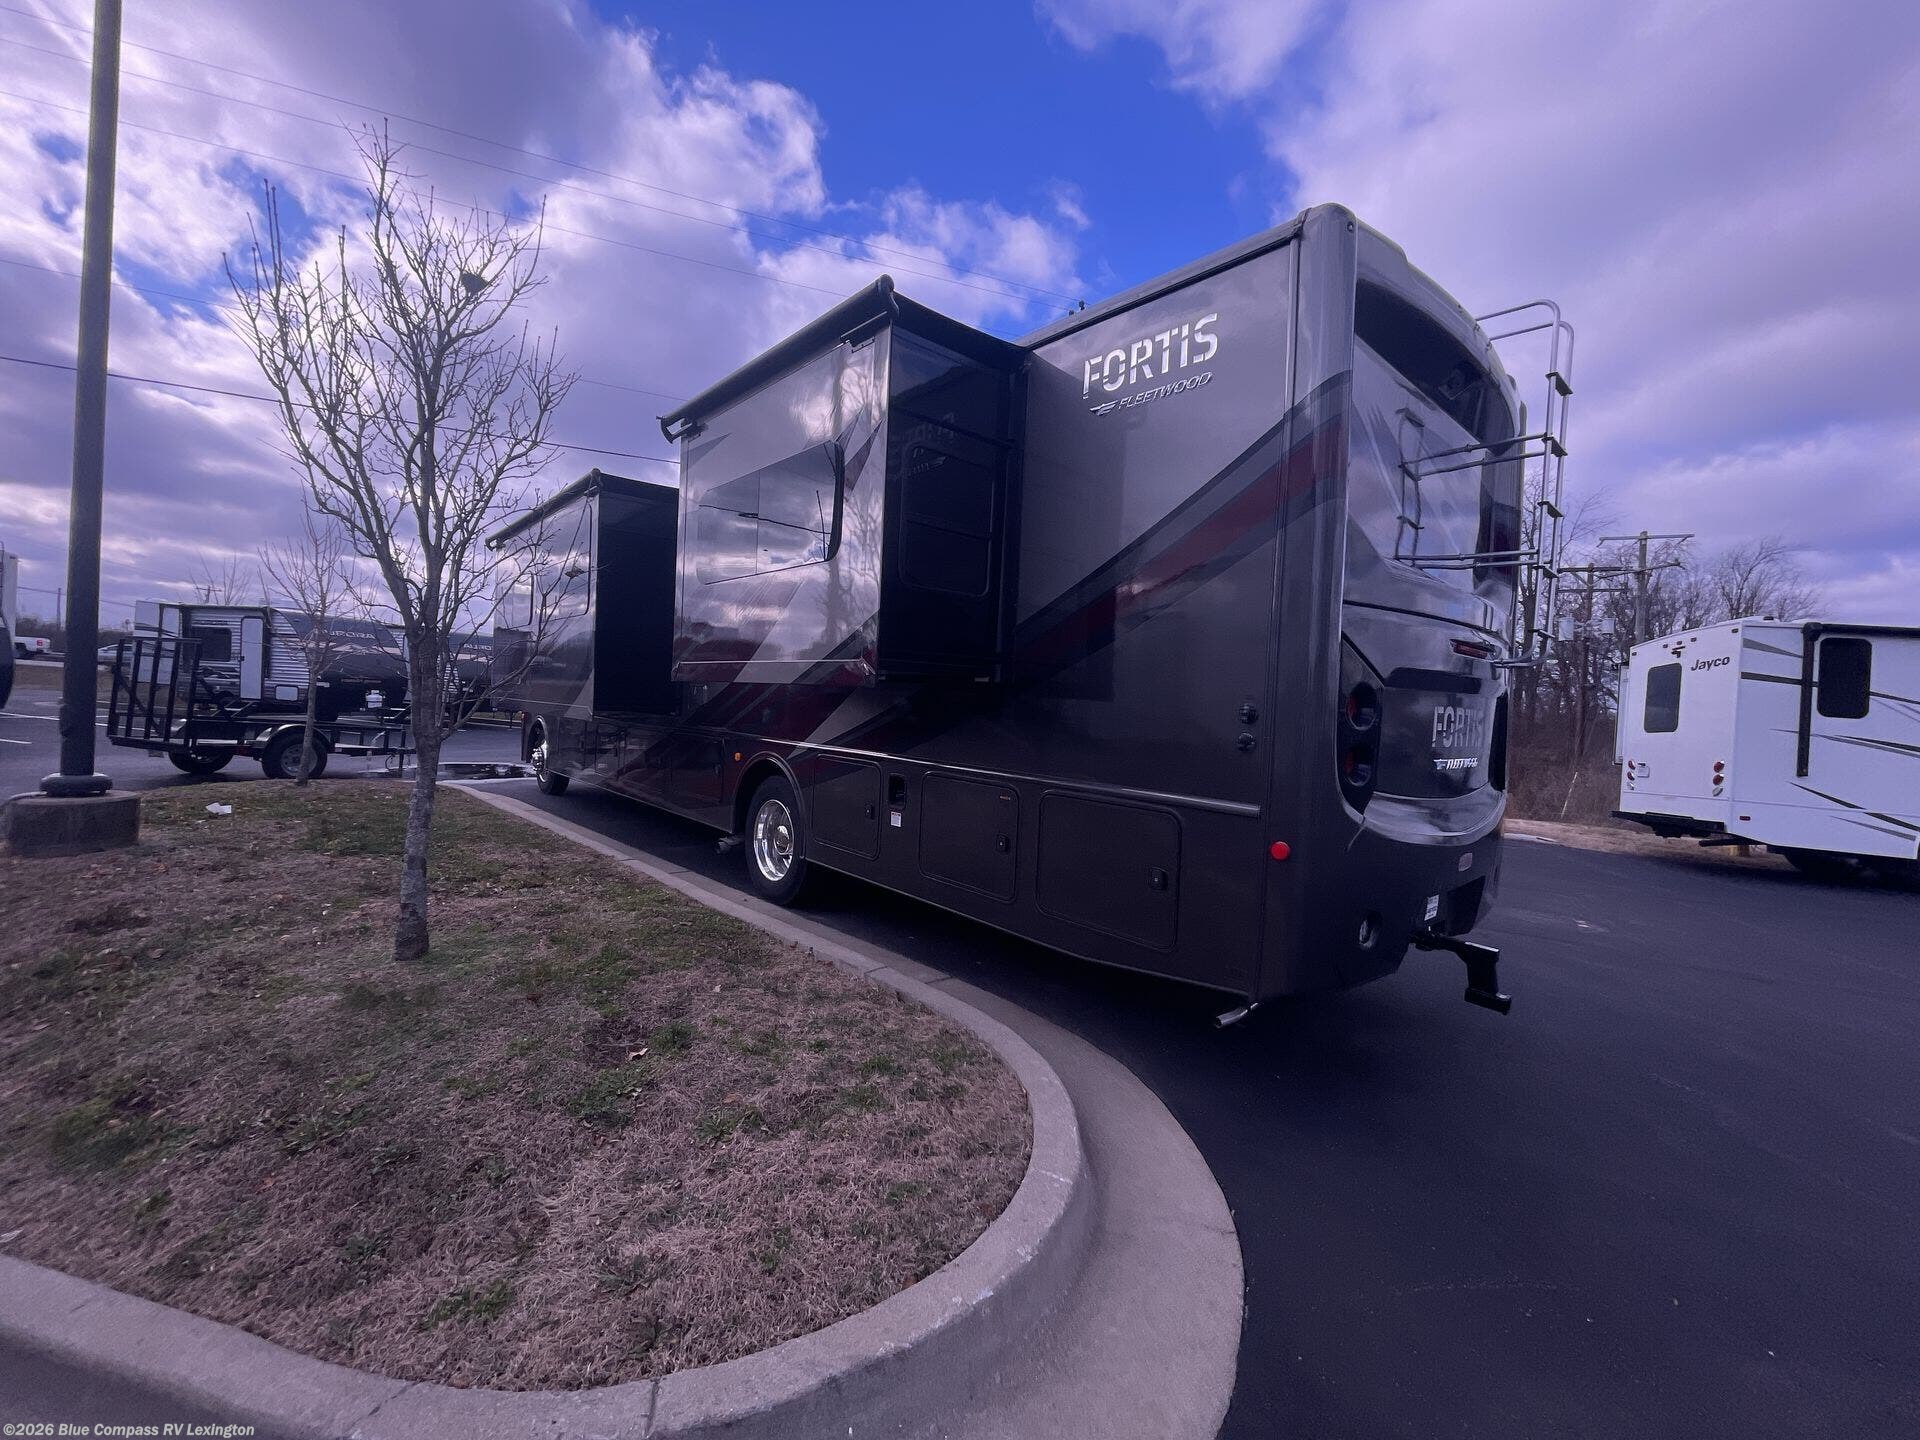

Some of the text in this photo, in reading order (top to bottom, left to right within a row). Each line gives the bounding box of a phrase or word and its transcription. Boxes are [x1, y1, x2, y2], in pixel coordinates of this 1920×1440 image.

[1082, 313, 1218, 399] FORTIS
[1118, 371, 1214, 410] FLEETWOOD
[1690, 656, 1731, 671] Jayco
